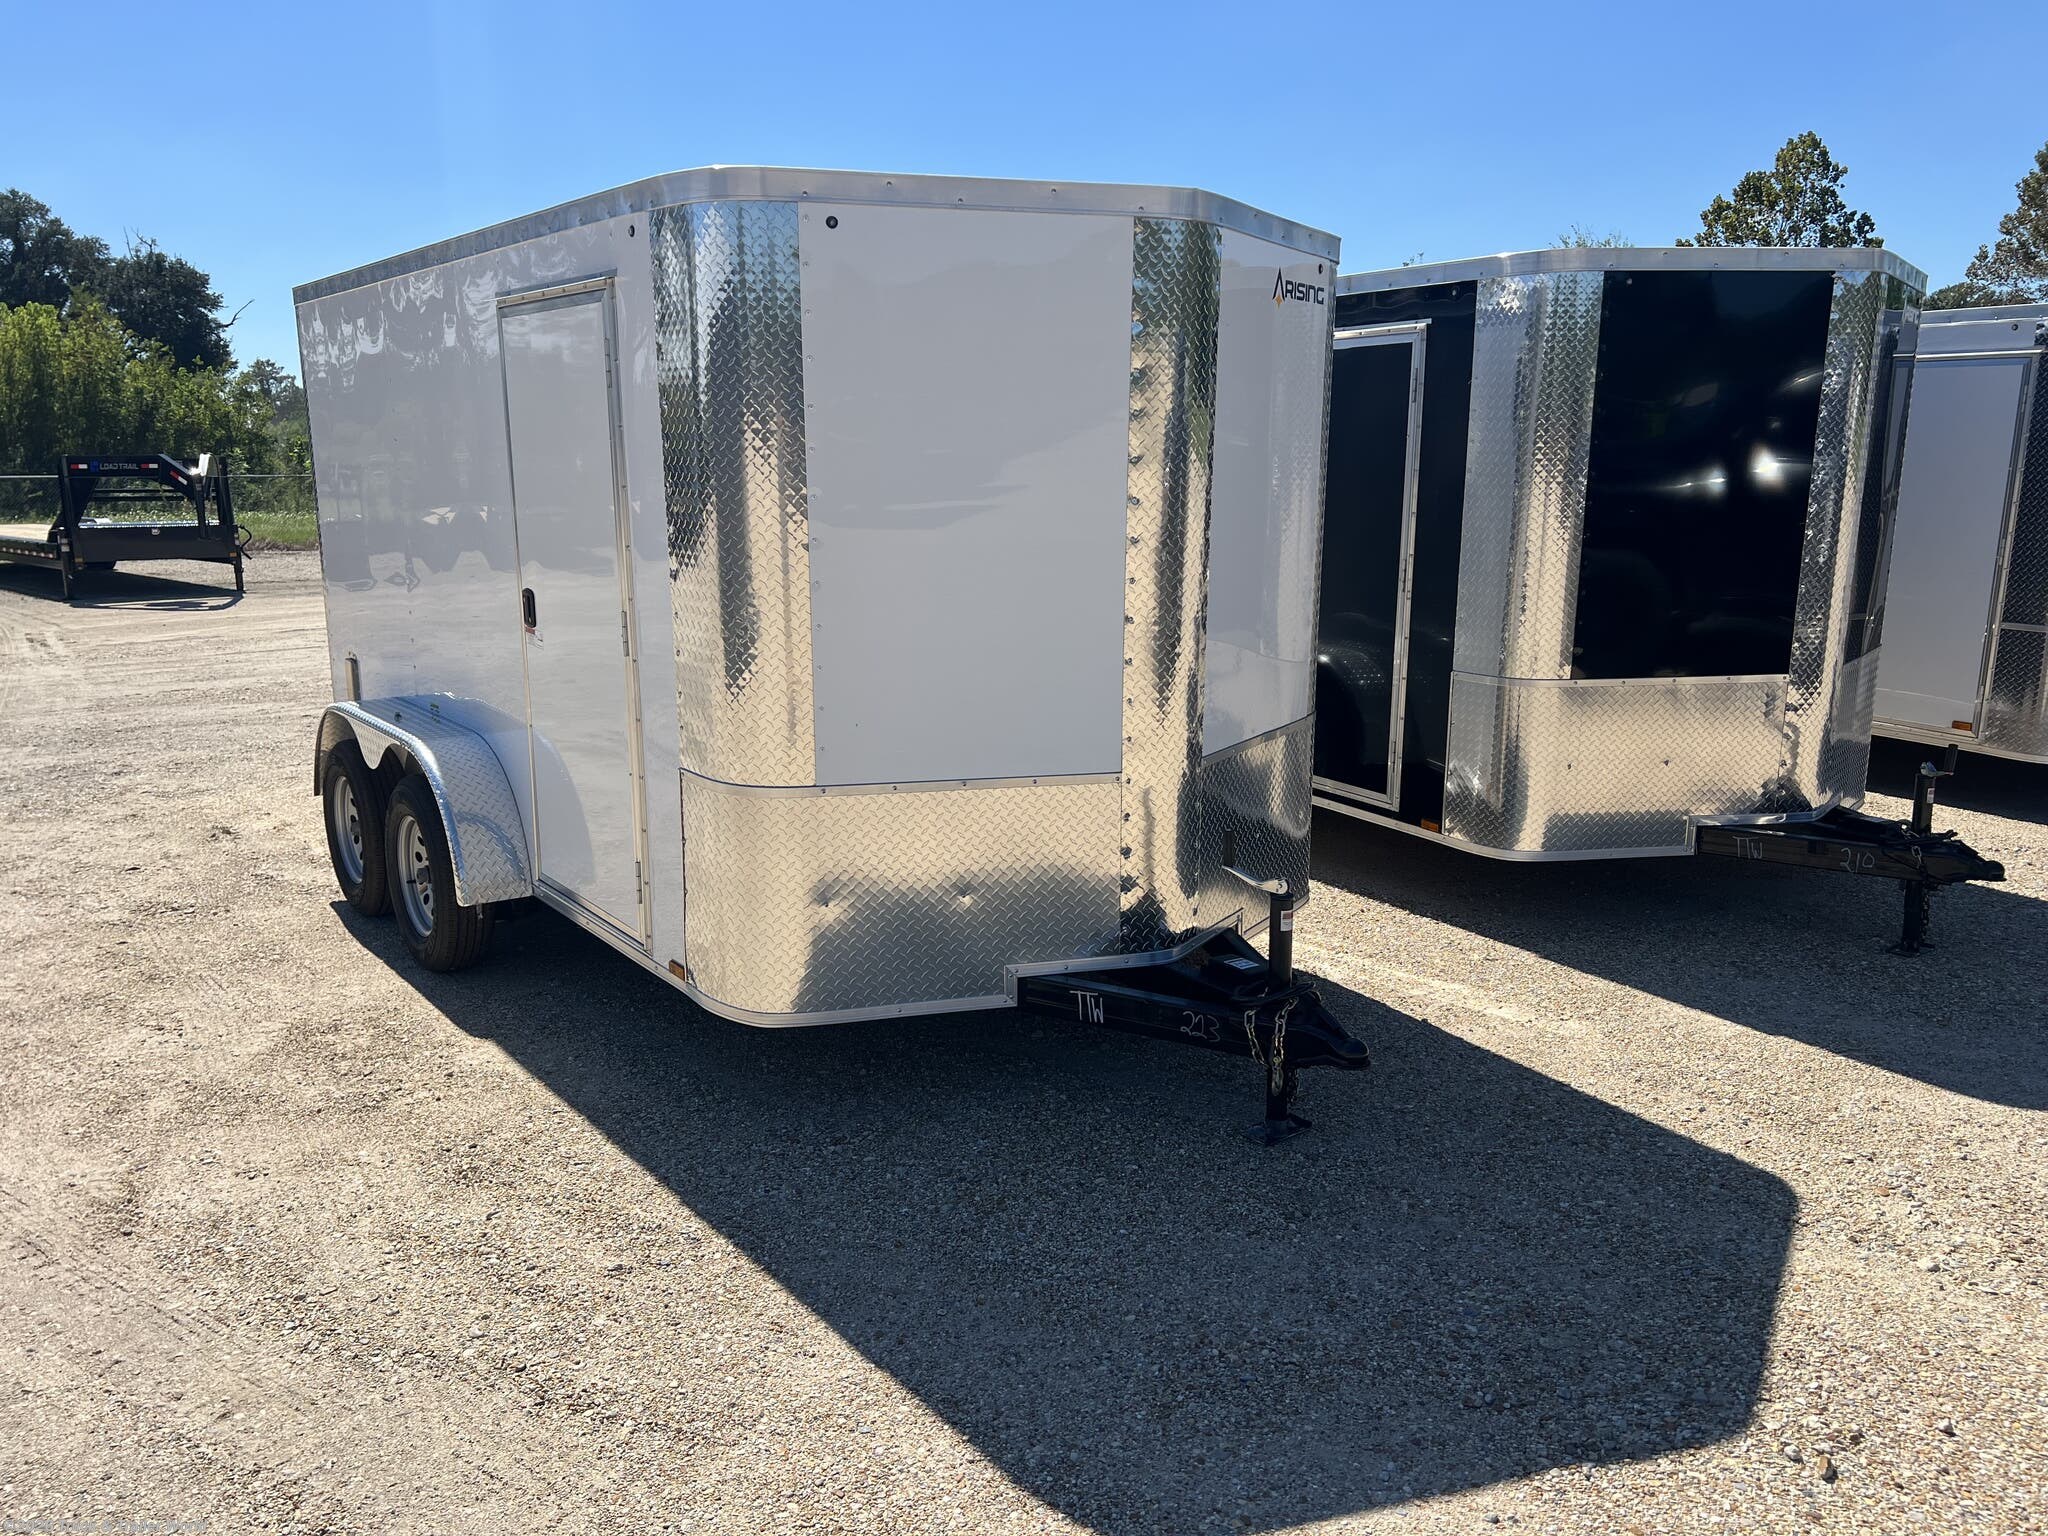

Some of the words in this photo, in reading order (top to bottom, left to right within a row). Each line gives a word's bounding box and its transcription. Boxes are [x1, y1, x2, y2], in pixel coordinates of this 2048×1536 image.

[1272, 267, 1324, 305] ARISING
[1840, 848, 1876, 873] 210
[1069, 990, 1104, 1024] TTW
